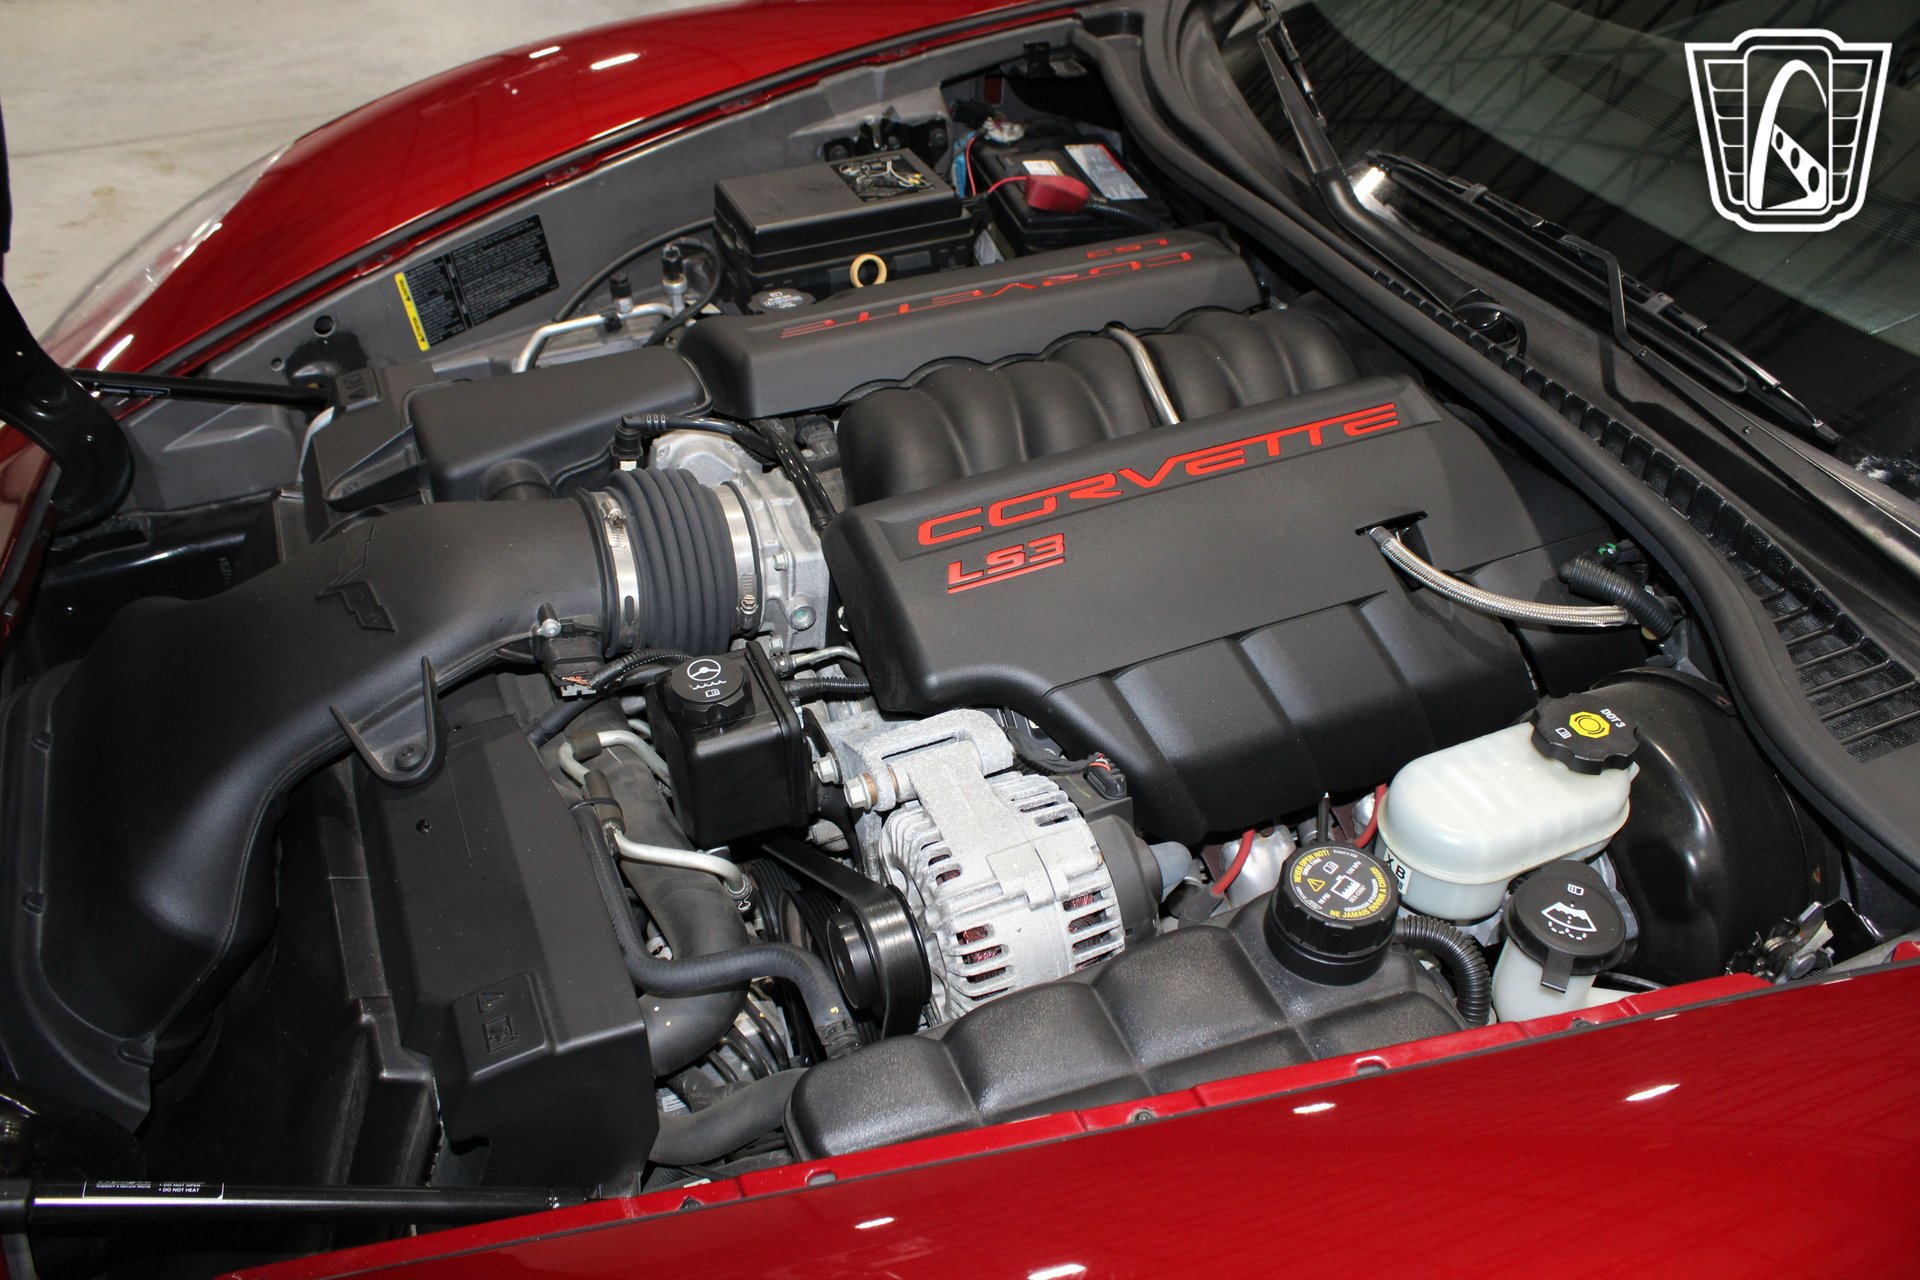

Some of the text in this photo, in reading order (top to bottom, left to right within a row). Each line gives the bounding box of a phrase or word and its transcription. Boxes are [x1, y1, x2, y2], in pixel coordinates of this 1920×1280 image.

[779, 252, 1192, 338] CORVETTE
[918, 403, 1399, 545] CORVETTE
[948, 533, 1064, 585] LS3
[1600, 708, 1621, 722] DOT
[1293, 849, 1330, 883] NEVER OPEN HOT!
[1329, 909, 1341, 918] NE
[1341, 908, 1371, 918] JAMAIS
[1368, 893, 1386, 912] OUVRIR
